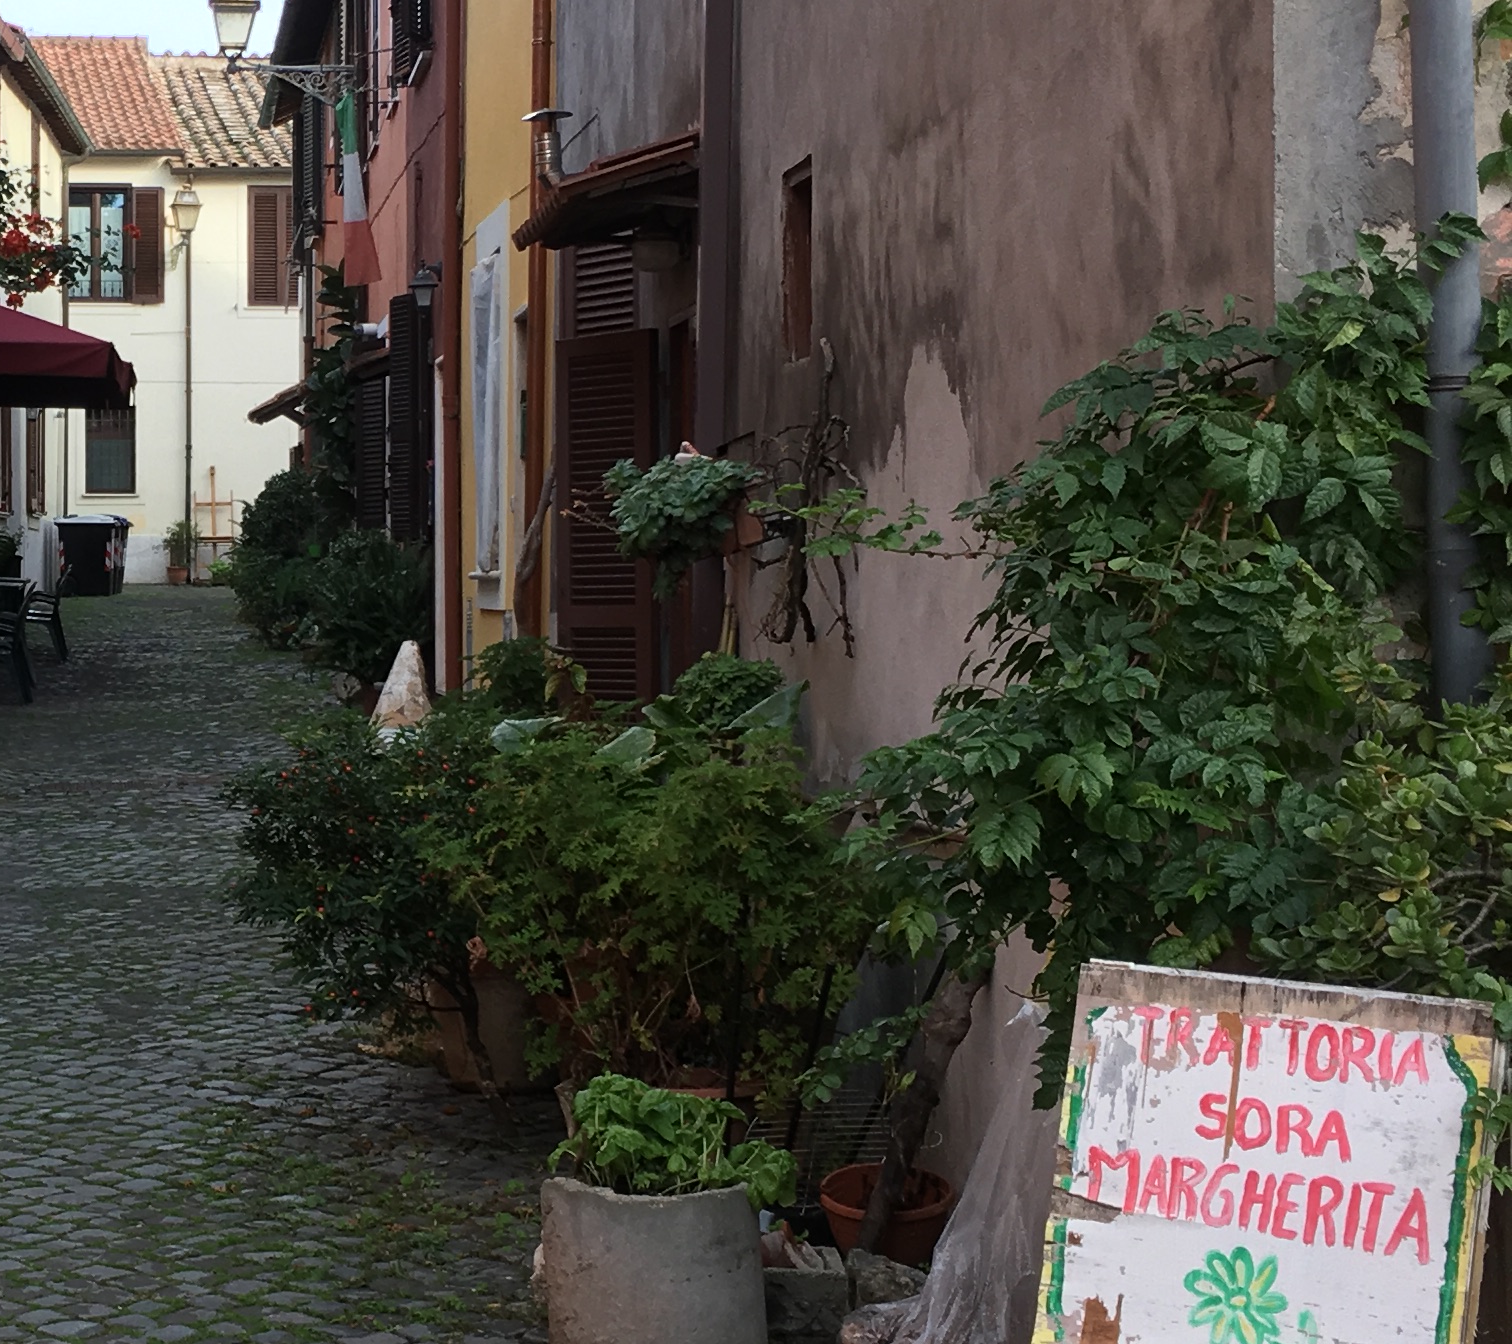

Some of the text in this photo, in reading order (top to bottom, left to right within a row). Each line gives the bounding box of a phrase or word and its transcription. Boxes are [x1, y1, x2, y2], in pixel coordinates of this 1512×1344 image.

[1133, 1006, 1429, 1086] TRATTORIA
[1195, 1093, 1352, 1163] SORA
[1088, 1145, 1430, 1265] MARGHERITA
